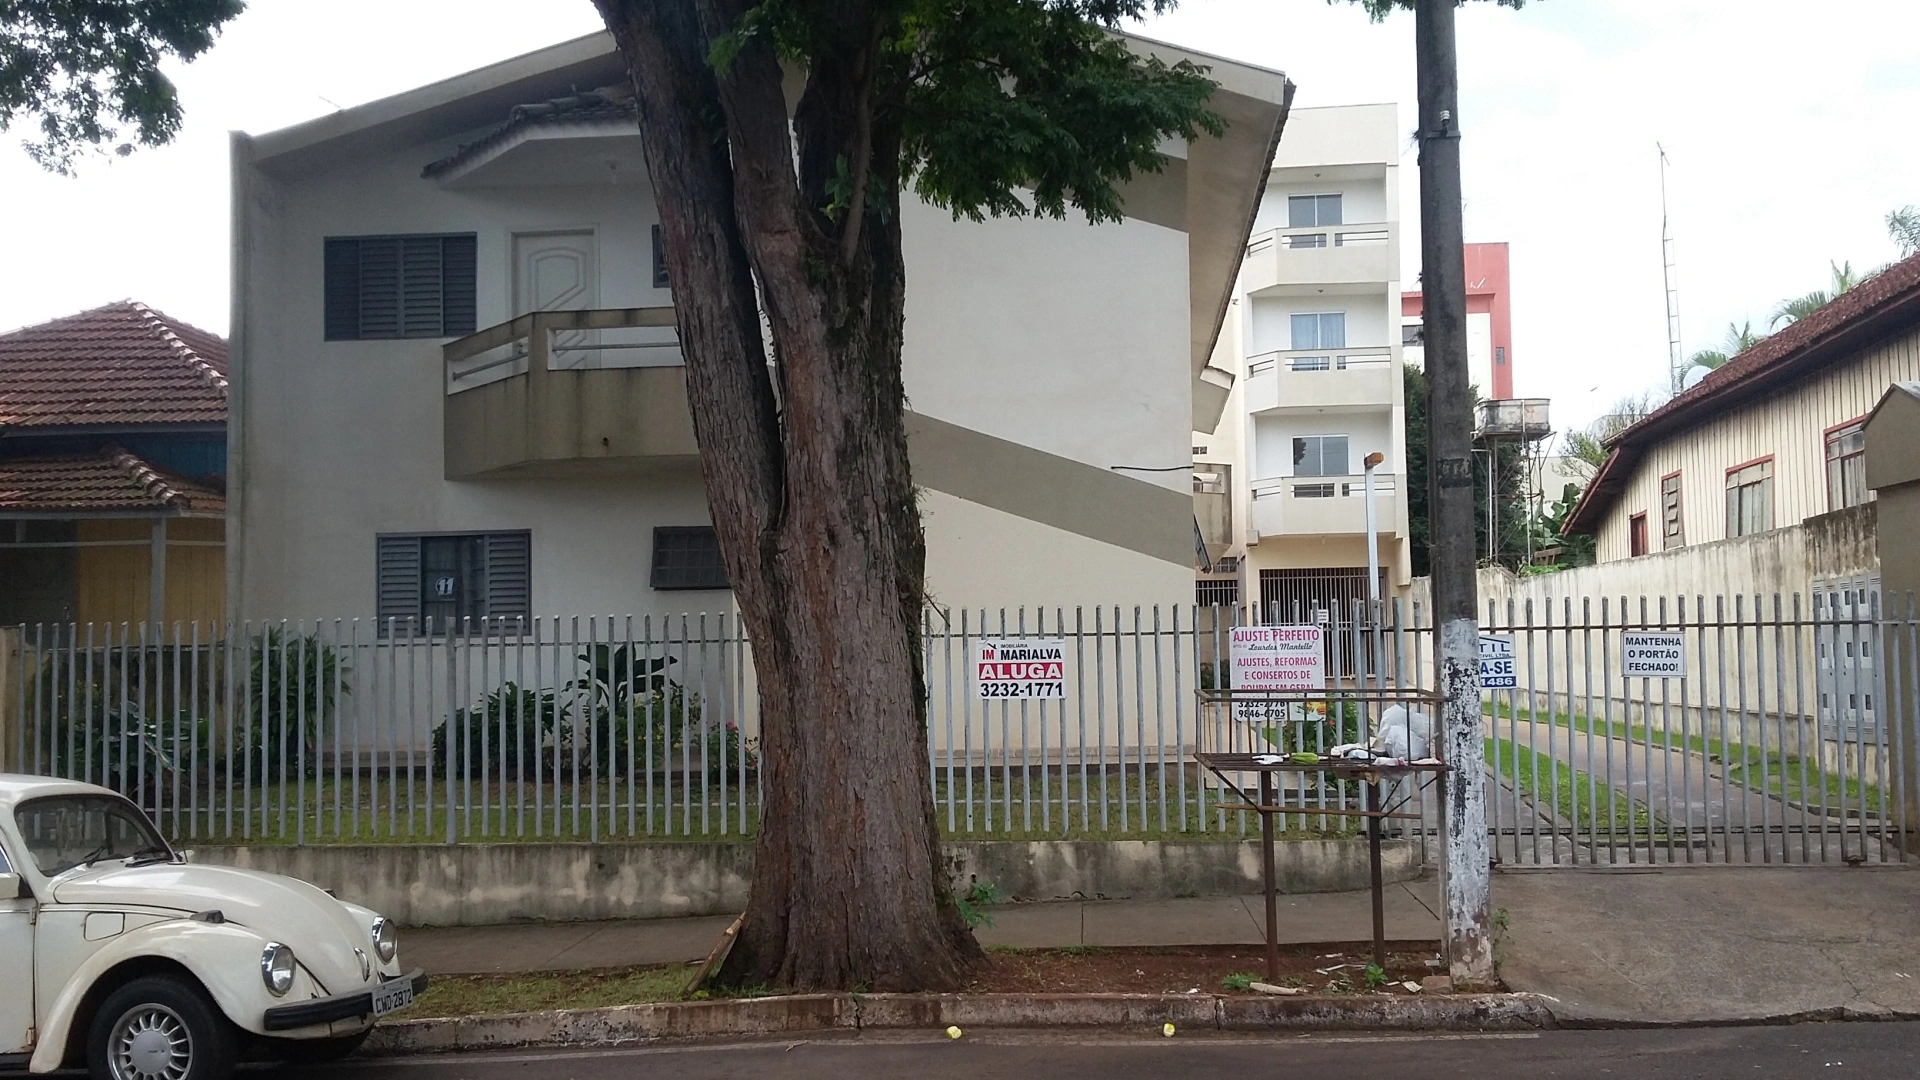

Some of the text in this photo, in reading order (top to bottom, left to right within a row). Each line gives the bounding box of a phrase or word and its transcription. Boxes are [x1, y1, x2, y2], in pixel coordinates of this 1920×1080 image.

[1233, 629, 1320, 642] AJUSTE PERFEITO
[1625, 636, 1681, 646] MANTENHA
[982, 648, 1062, 660] IM MARIALVA
[1628, 648, 1679, 659] O PORTÃO
[1237, 656, 1317, 668] AJUSTES, REFORMAS
[1628, 662, 1679, 671] FECHADO!
[980, 663, 1062, 679] ALUGA
[1244, 670, 1311, 680] E CONSERTOS DE
[980, 682, 1063, 697] 3232-1771
